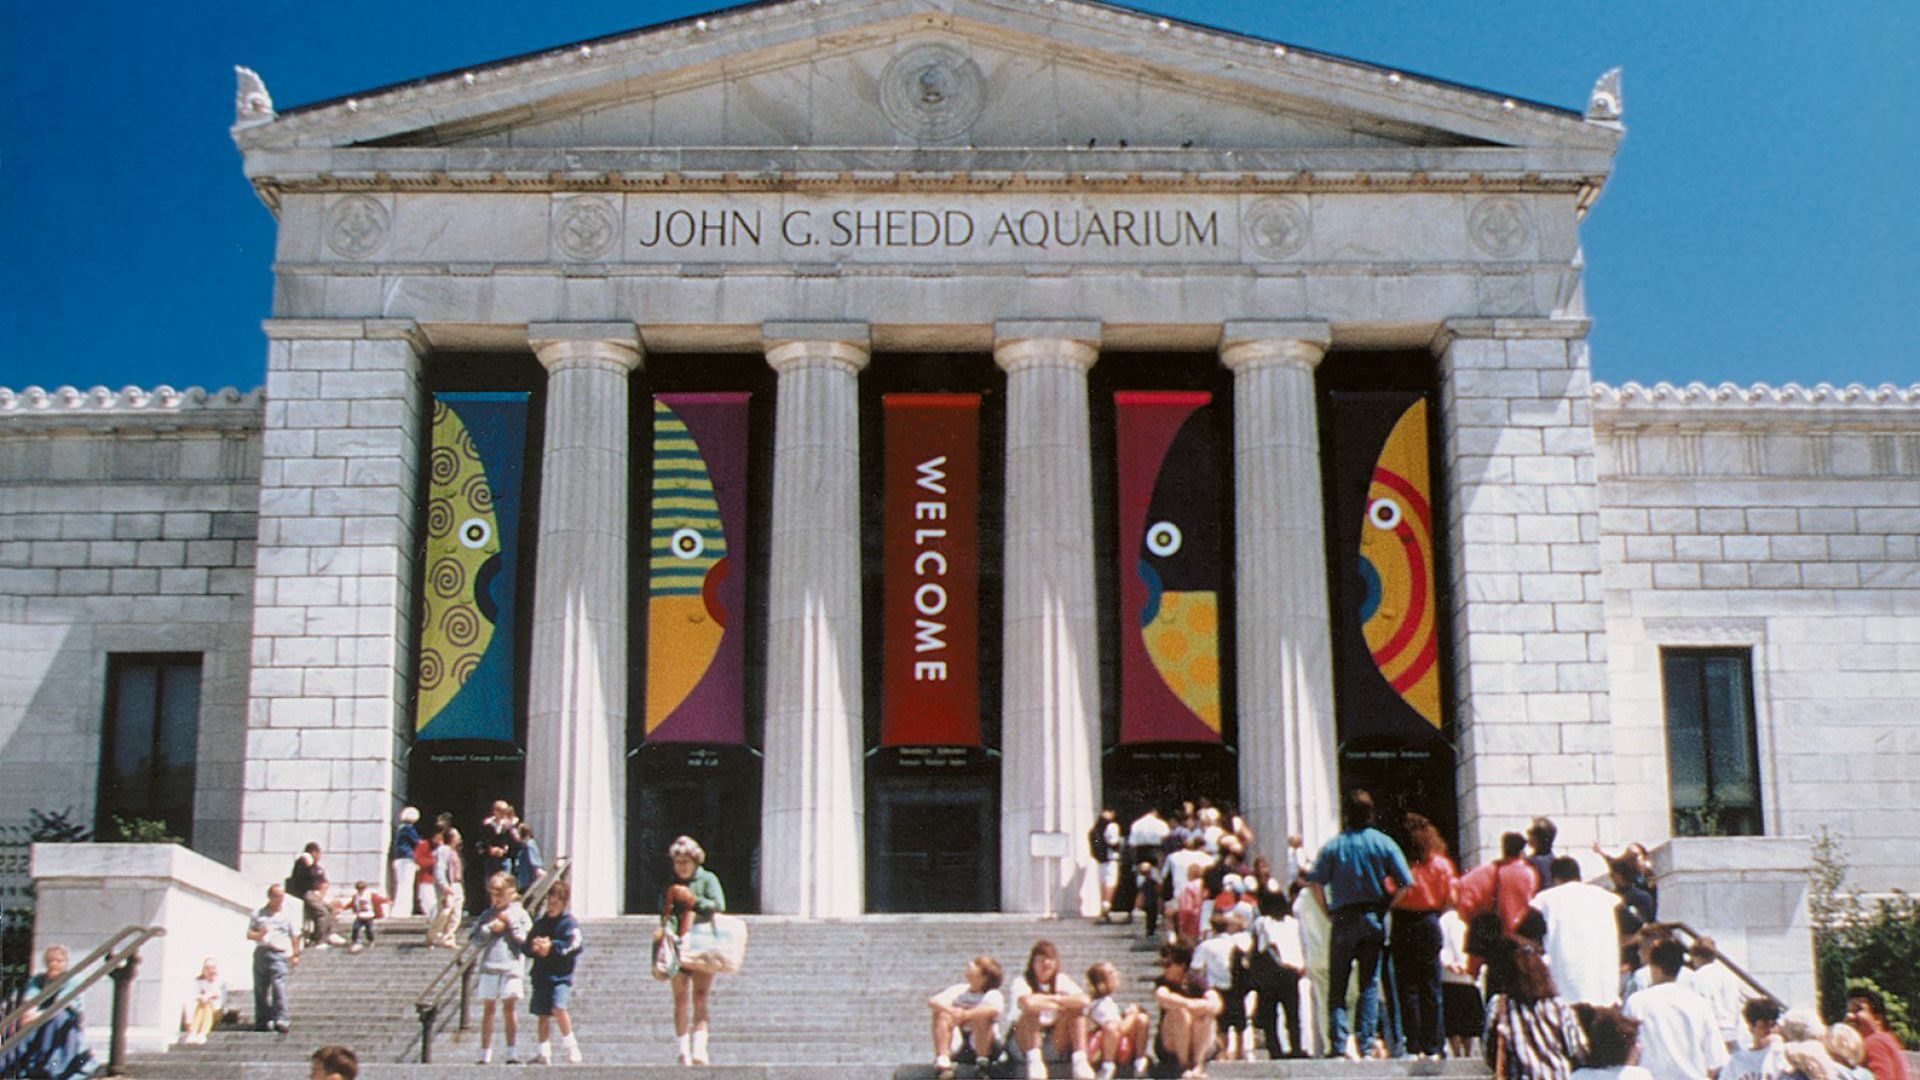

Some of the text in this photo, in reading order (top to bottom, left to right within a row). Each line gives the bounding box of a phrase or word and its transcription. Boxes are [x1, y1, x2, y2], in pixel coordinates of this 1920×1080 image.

[639, 209, 1219, 250] JOHN G. SHEDD AQUARIUM
[914, 455, 948, 682] WELCOME
